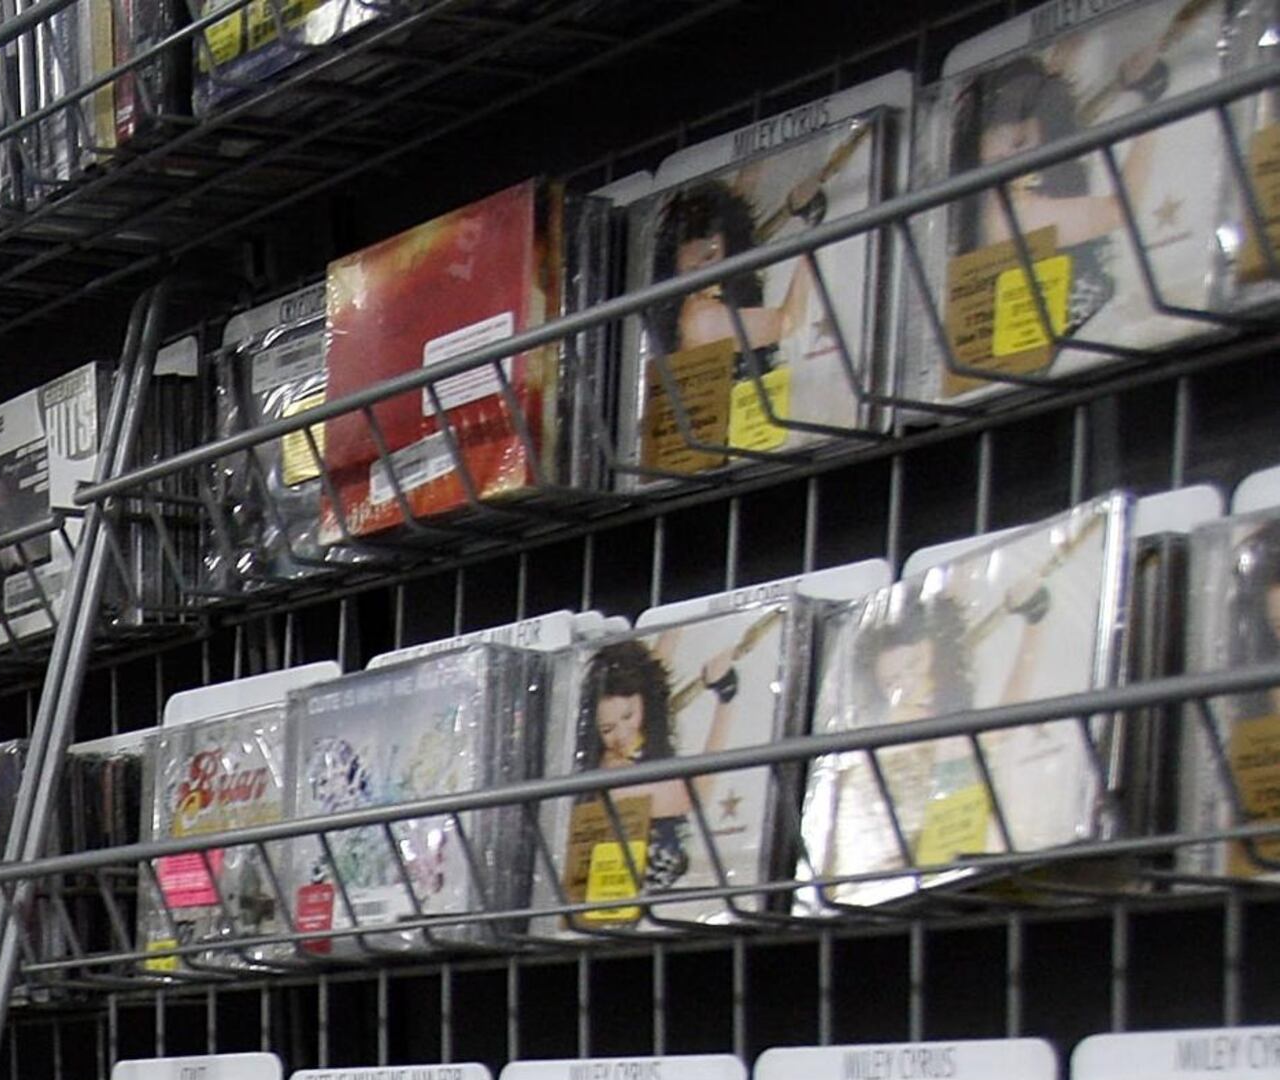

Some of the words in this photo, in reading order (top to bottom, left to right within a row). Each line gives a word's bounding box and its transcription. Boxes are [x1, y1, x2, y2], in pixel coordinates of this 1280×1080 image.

[45, 386, 97, 461] HITS
[842, 1050, 893, 1080] MILEY
[899, 1046, 956, 1079] CYRUS
